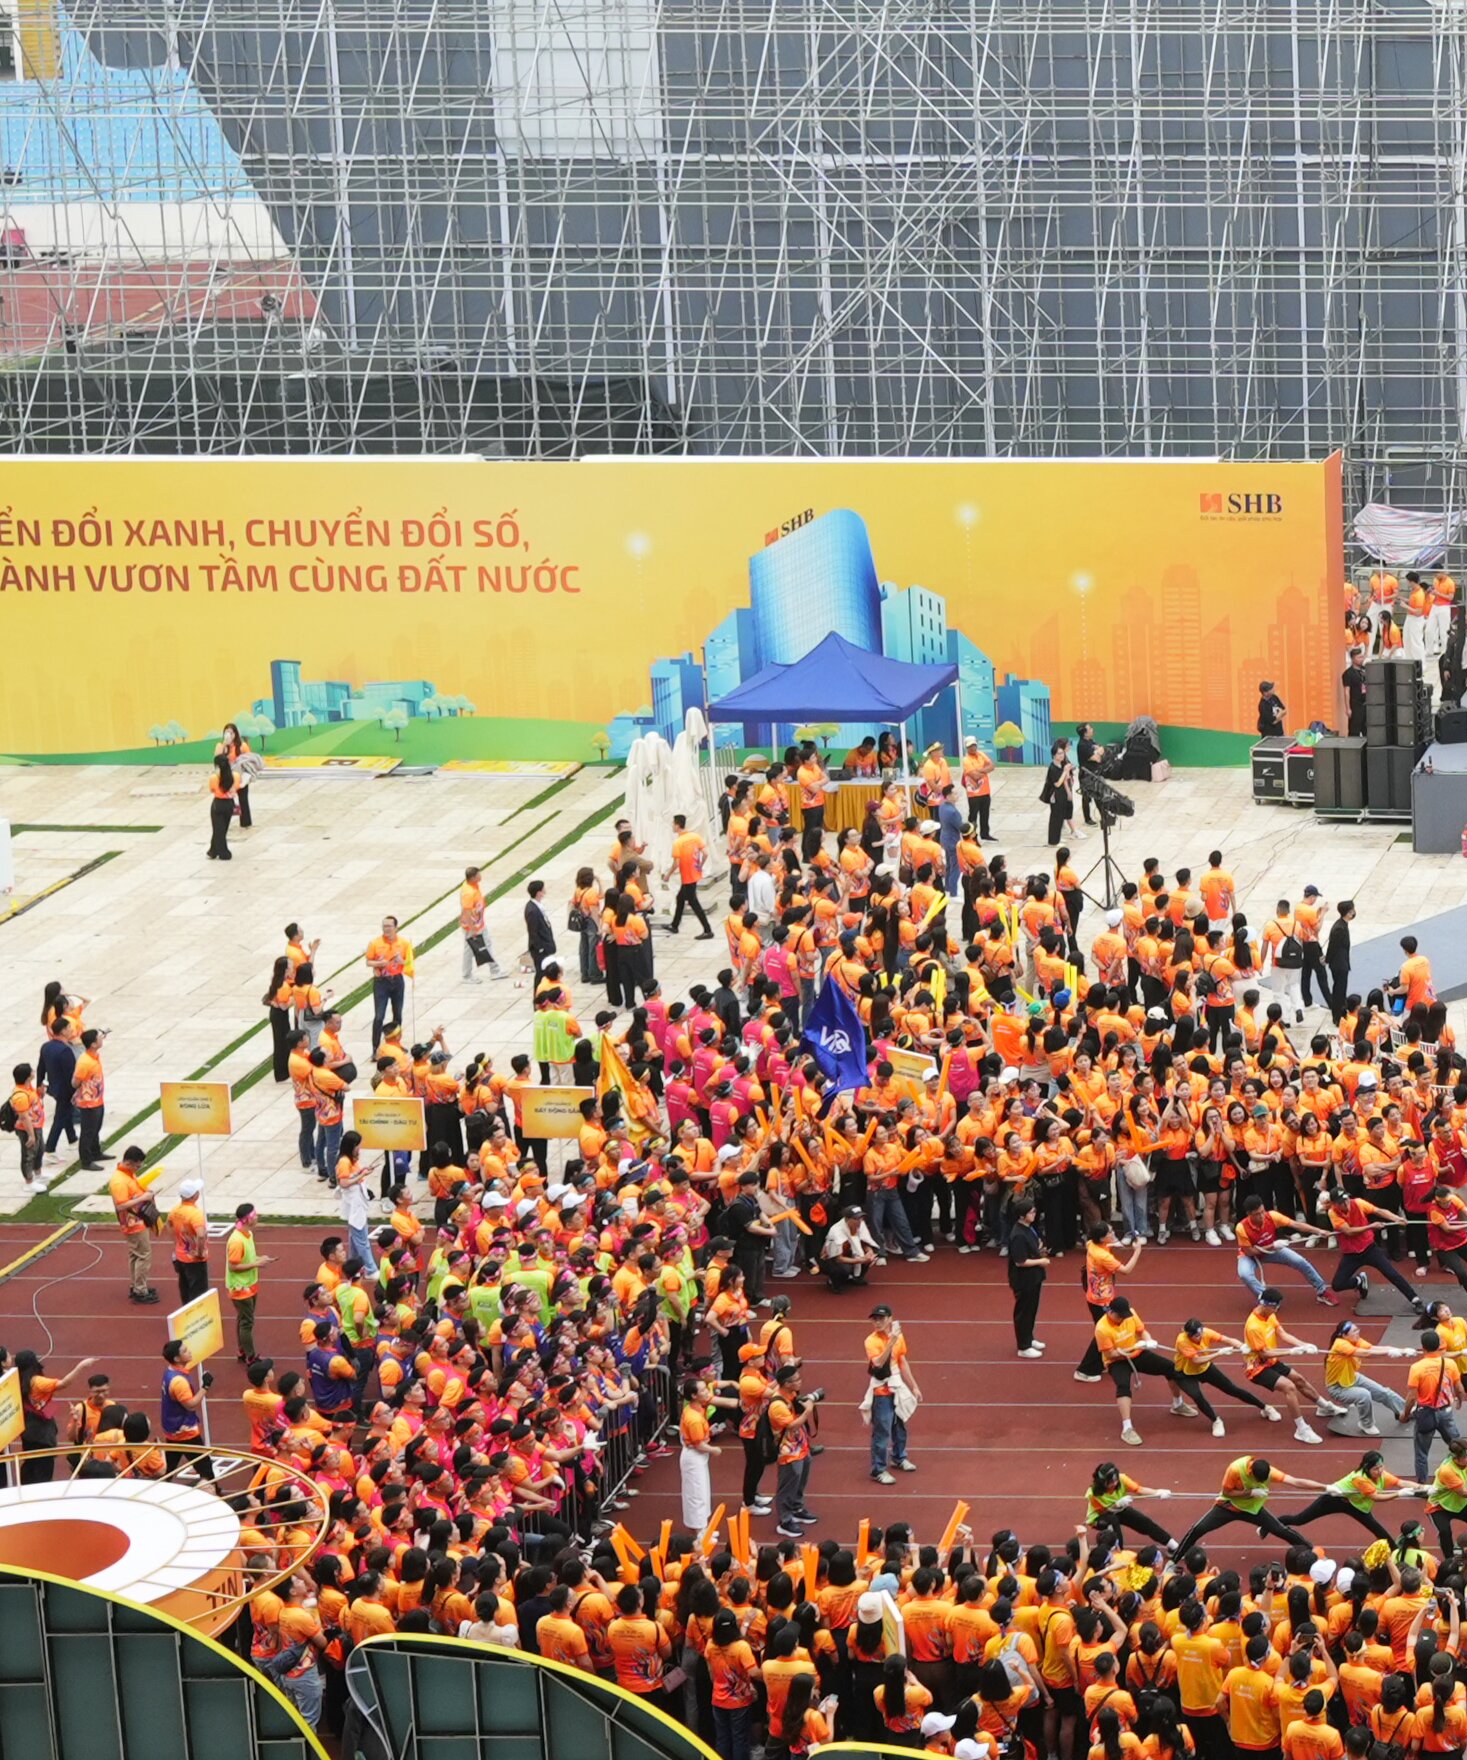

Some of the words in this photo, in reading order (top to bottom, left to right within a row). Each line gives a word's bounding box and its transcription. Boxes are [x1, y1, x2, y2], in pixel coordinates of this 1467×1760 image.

[1228, 493, 1282, 514] SHB
[51, 506, 113, 547] ĐỔI
[123, 519, 235, 552] XANH,
[245, 506, 391, 547] CHUYỂN
[400, 506, 462, 548] ĐỔI
[473, 508, 529, 552] SỐ,
[781, 508, 814, 538] SHB
[0, 556, 75, 592] ÀNH
[84, 563, 190, 592] VƯƠN
[198, 553, 278, 592] TẦM
[288, 556, 388, 593] CÙNG
[397, 553, 467, 593] ĐẤT
[477, 557, 581, 593] NƯỚC
